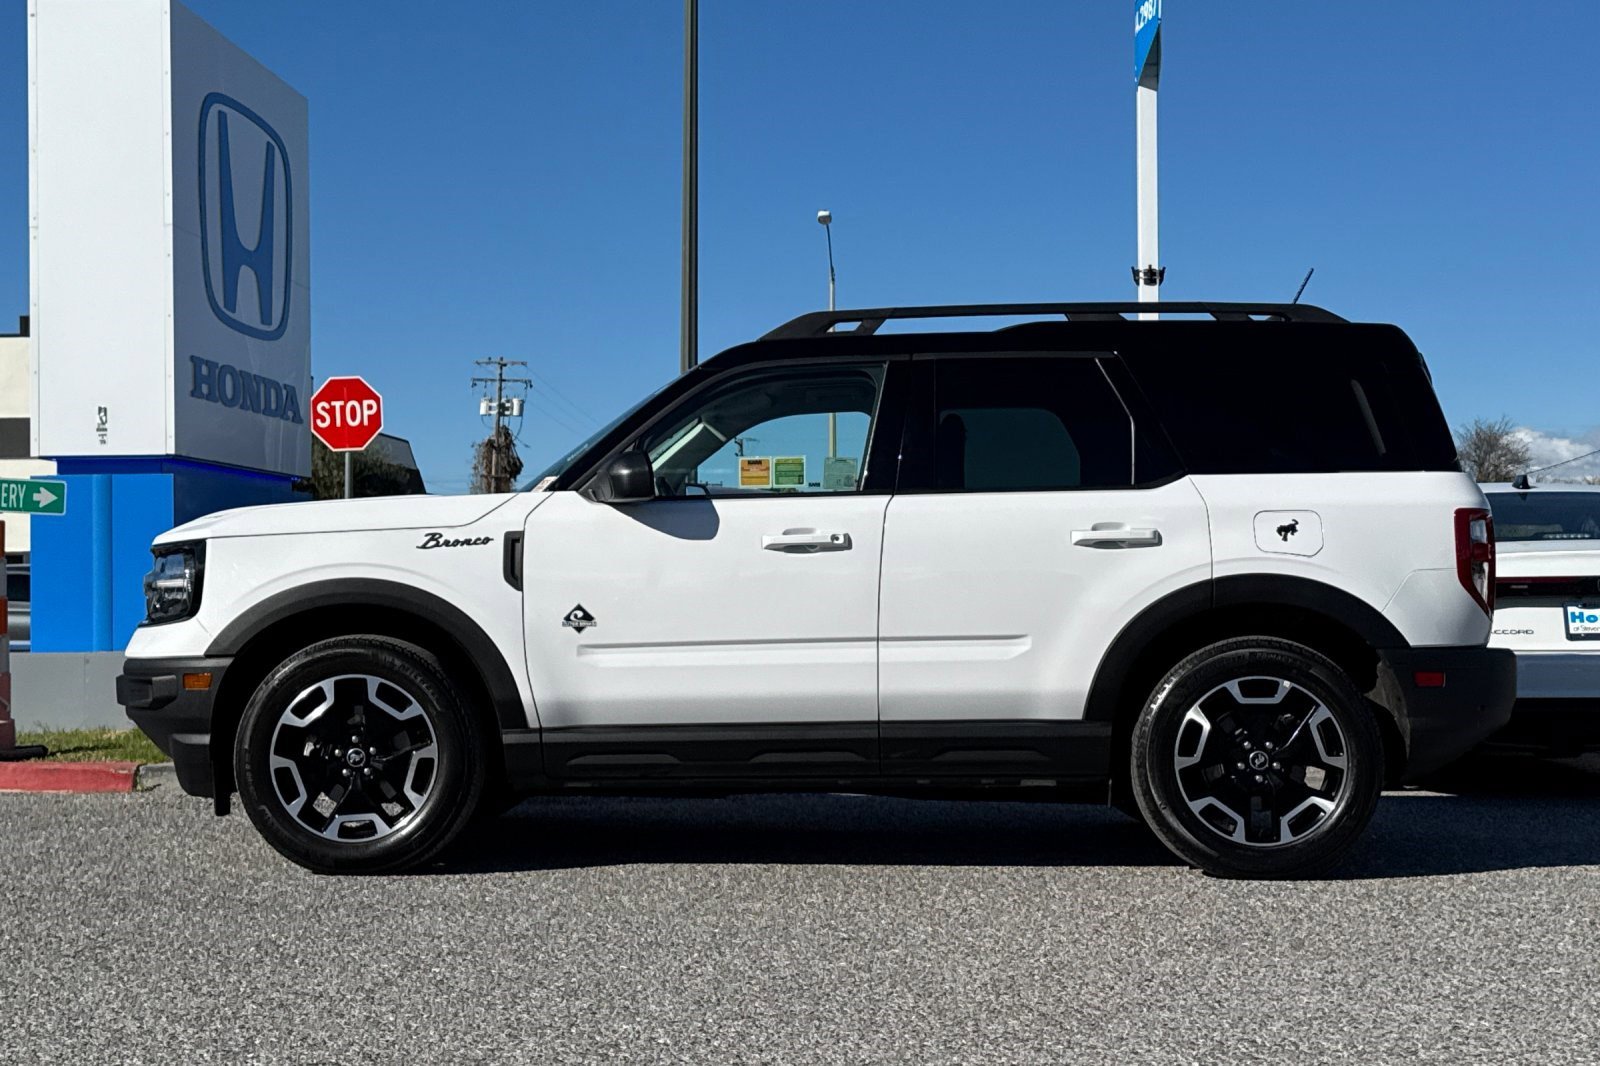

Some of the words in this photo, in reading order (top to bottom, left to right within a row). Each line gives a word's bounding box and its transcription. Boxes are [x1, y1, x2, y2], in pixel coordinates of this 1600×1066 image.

[190, 355, 304, 424] HONDA
[316, 400, 377, 428] STOP
[1, 483, 26, 508] ERY
[416, 532, 494, 549] Bronco
